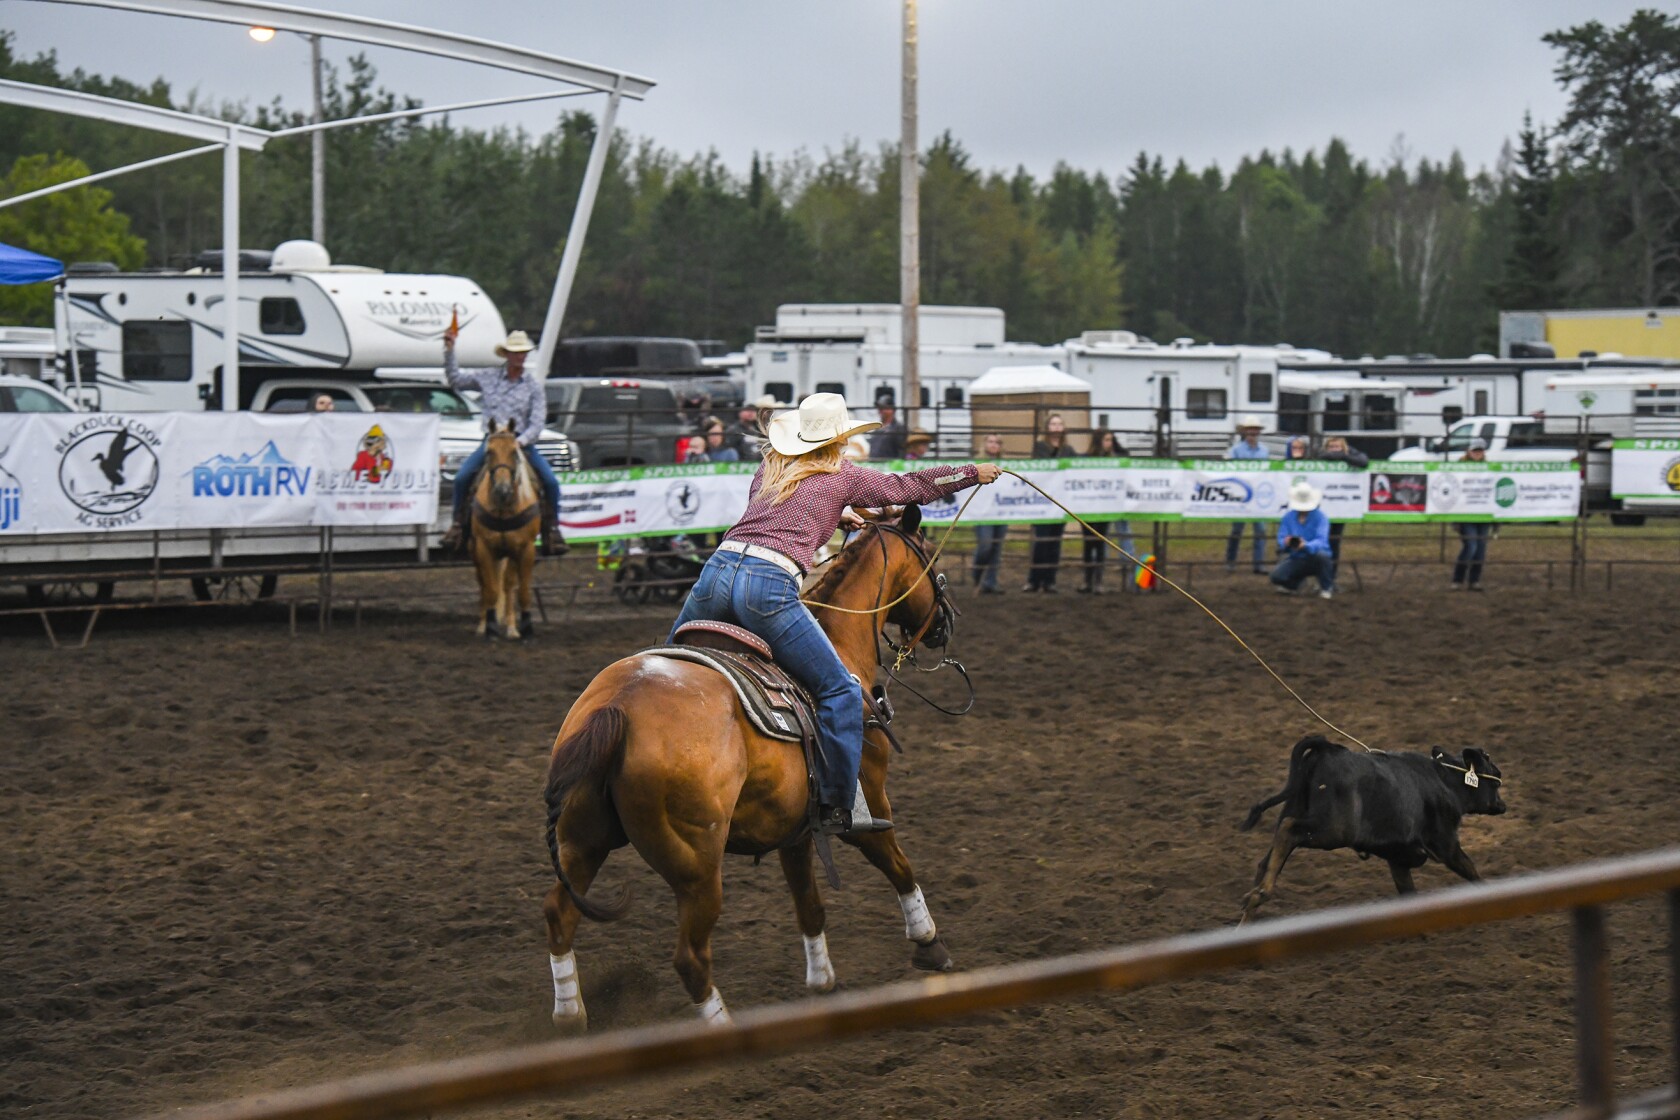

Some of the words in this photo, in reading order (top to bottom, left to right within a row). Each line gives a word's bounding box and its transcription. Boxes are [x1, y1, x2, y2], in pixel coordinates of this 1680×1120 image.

[366, 300, 468, 316] PALOMINO
[54, 415, 125, 454] BLACKDUCK
[127, 417, 162, 447] COOP
[193, 466, 271, 497] ROTH
[276, 466, 311, 496] RV
[643, 465, 716, 477] SPONSOR
[0, 488, 19, 530] ji
[75, 512, 93, 527] AG
[97, 508, 143, 528] SERVICE
